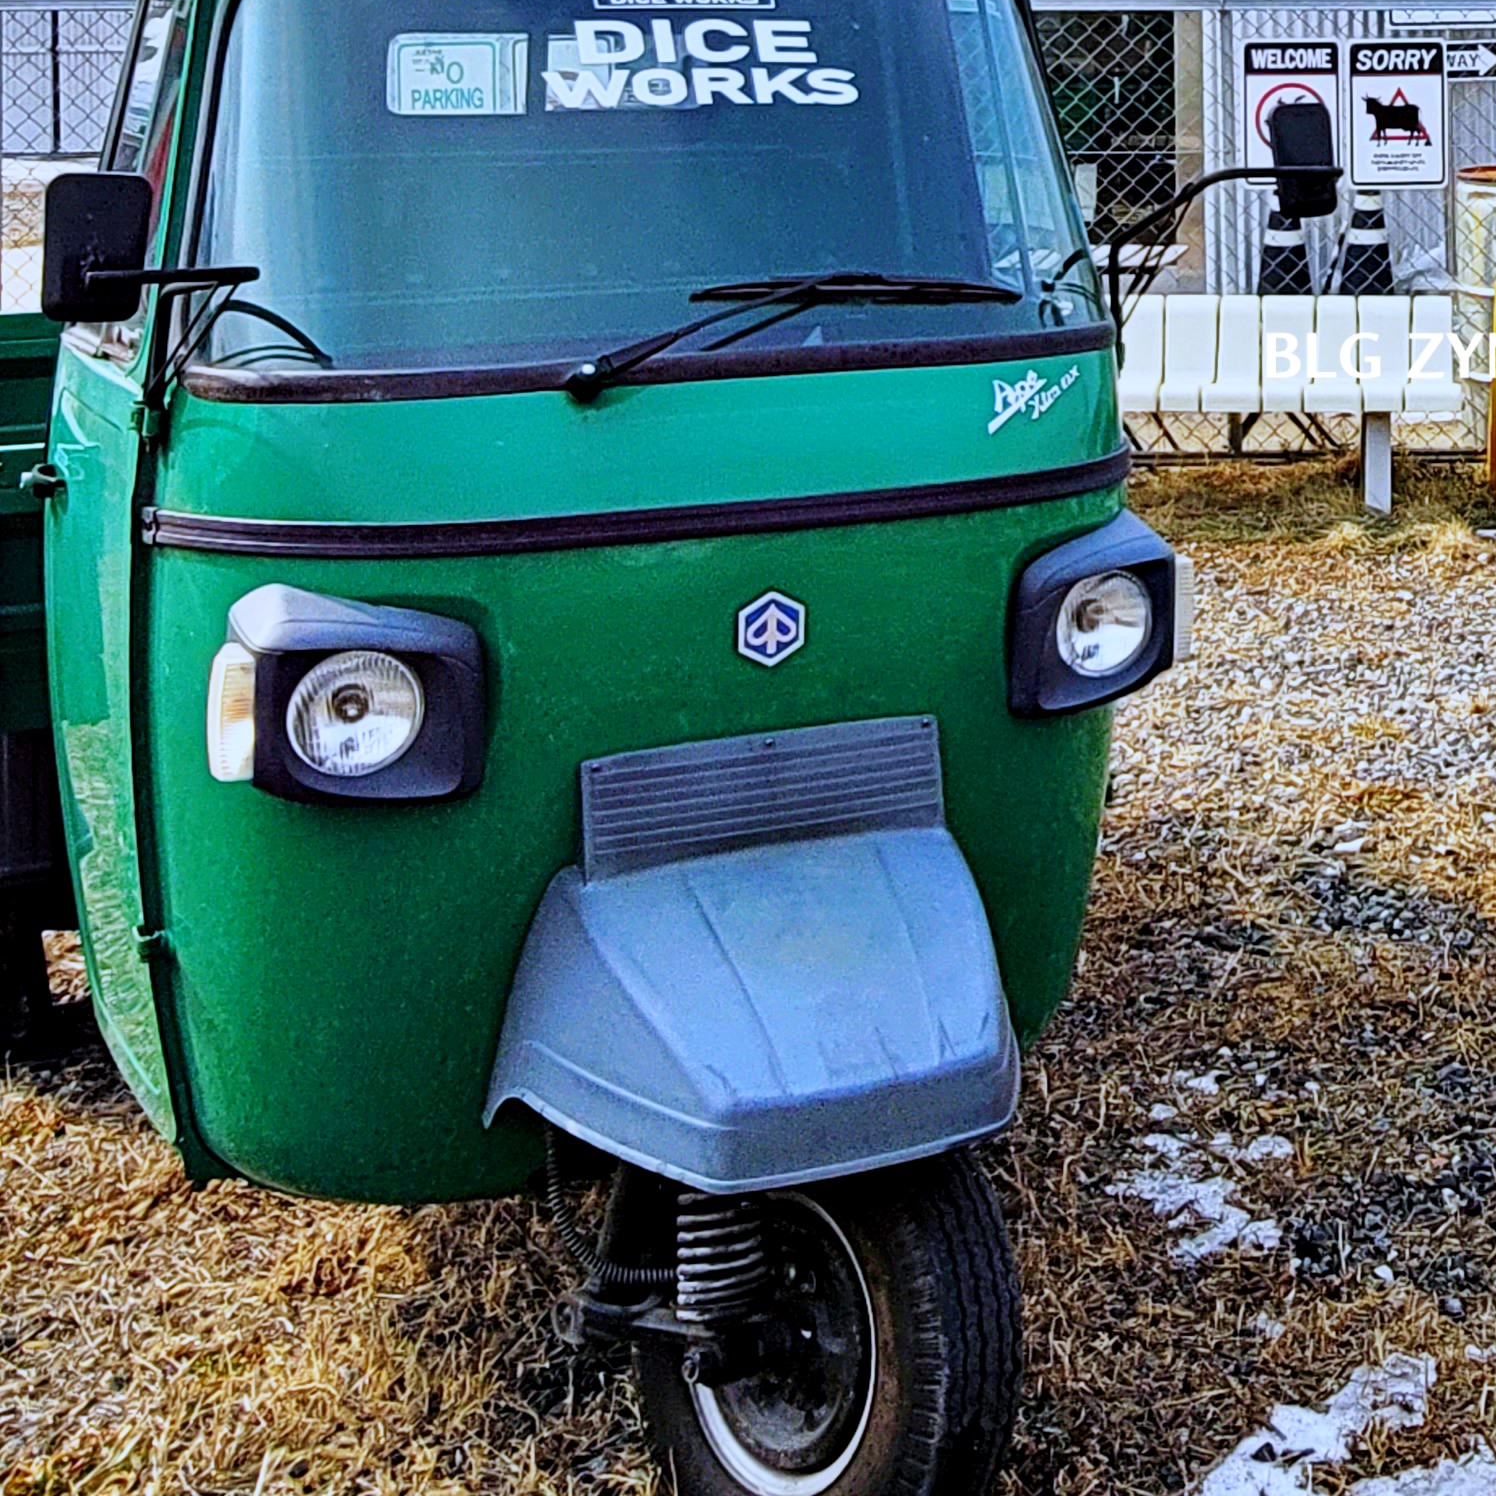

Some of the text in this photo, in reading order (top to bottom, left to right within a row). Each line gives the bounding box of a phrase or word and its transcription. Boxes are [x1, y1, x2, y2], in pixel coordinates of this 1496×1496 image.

[574, 18, 818, 65] DICE
[1251, 48, 1333, 70] WELCOME
[1356, 49, 1438, 72] SORRY
[410, 87, 485, 111] PARKING
[541, 67, 859, 109] WORKS
